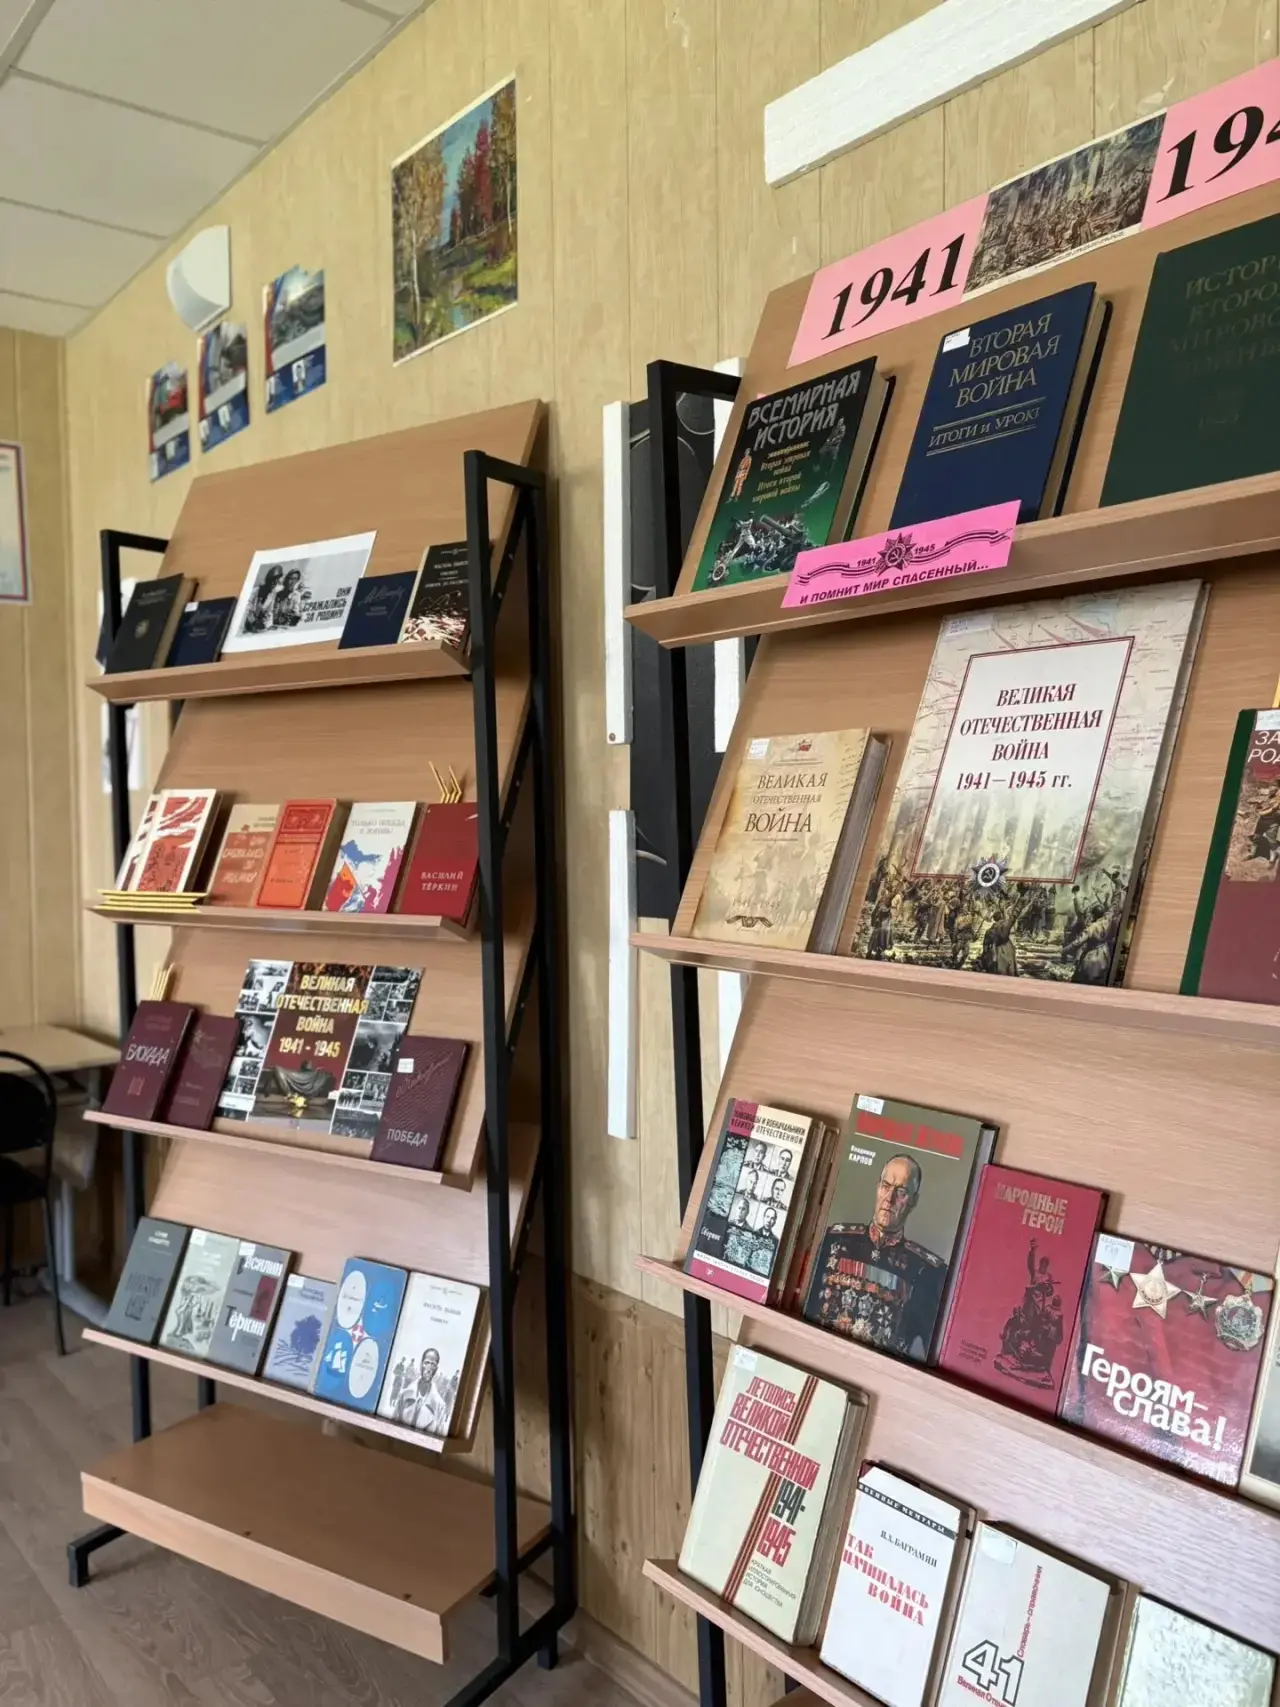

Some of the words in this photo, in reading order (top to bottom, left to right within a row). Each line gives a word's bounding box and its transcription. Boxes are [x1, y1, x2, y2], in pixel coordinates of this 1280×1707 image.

[821, 233, 965, 340] 1941
[968, 313, 1052, 358] ВТОРАЯ
[949, 334, 1062, 387] МИРОВАЯ
[747, 370, 861, 430] ВСЕМИРНАЯ
[955, 367, 1038, 408] ВОЙНА
[753, 403, 839, 451] ИСТОРИЯ
[928, 423, 978, 447] ИТОГИ
[857, 557, 877, 567] 1941
[914, 543, 935, 555] 1945
[799, 595, 809, 605] И
[810, 584, 860, 604] ПОМНИТ
[863, 578, 890, 593] МИР
[893, 559, 989, 586] СПАСЕННЫЙ...
[996, 683, 1077, 707] ВЕЛИКАЯ
[959, 709, 1104, 736] ОТЕЧЕСТВЕННАЯ
[992, 739, 1050, 761] ВОЙНА
[757, 772, 829, 789] ВЕЛИКАЯ
[1051, 773, 1073, 788] гг.
[752, 793, 822, 804] ОТЕЧЕСТВЕННАЯ
[744, 806, 812, 833] ВОЙНА
[420, 871, 464, 880] ВАСИЛИЙ
[421, 881, 460, 891] ТЁРКИН
[300, 974, 355, 992] ВЕЛИКАЯ
[276, 994, 370, 1014] ОТЕЧЕСТВЕННАЯ
[295, 1014, 335, 1034] ВОЙНА
[279, 1037, 304, 1054] 1941
[314, 1040, 341, 1058] 1945
[387, 1128, 429, 1147] ПОБЕДА
[848, 1153, 873, 1166] КАРПОВ
[995, 1182, 1068, 1216] НАРОДНЫЕ
[1022, 1208, 1064, 1235] ГЕРОИ
[746, 1376, 796, 1413] ЛЕТОПИСЬ
[729, 1391, 793, 1441] ВЕЛИКОЙ
[720, 1418, 821, 1491] ОТЕЧЕСТВЕННОЙ
[859, 1483, 899, 1509] ВОЕННЫЕ
[902, 1507, 945, 1533] МЕМУАРЫ
[757, 1516, 796, 1567] 1945
[848, 1533, 875, 1560] ТАК
[842, 1549, 929, 1609] НАЧИНАЛАСЬ
[867, 1581, 924, 1626] ВОЙНА
[962, 1639, 1024, 1707] 41
